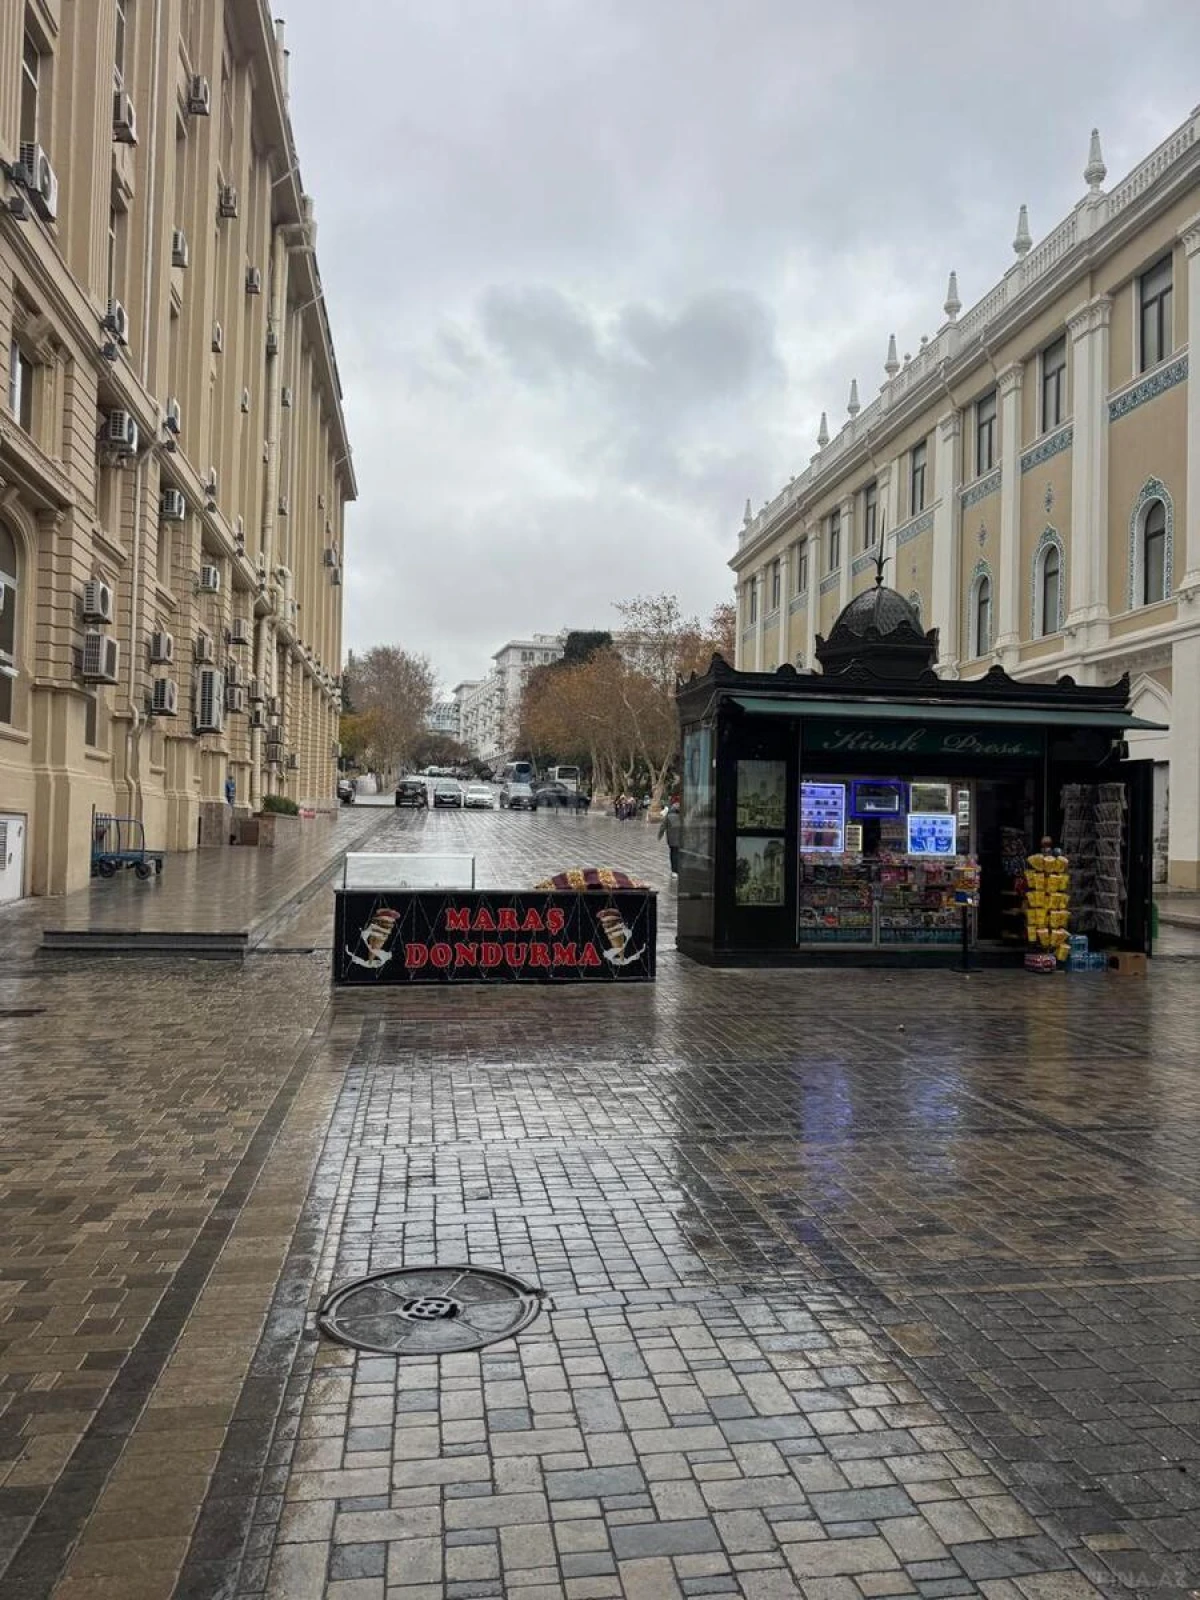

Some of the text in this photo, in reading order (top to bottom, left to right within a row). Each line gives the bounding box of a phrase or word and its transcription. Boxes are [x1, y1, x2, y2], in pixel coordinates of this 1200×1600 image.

[823, 728, 927, 751] Kiosk
[446, 908, 565, 935] MARAŞ
[405, 943, 601, 968] DONDURMA
